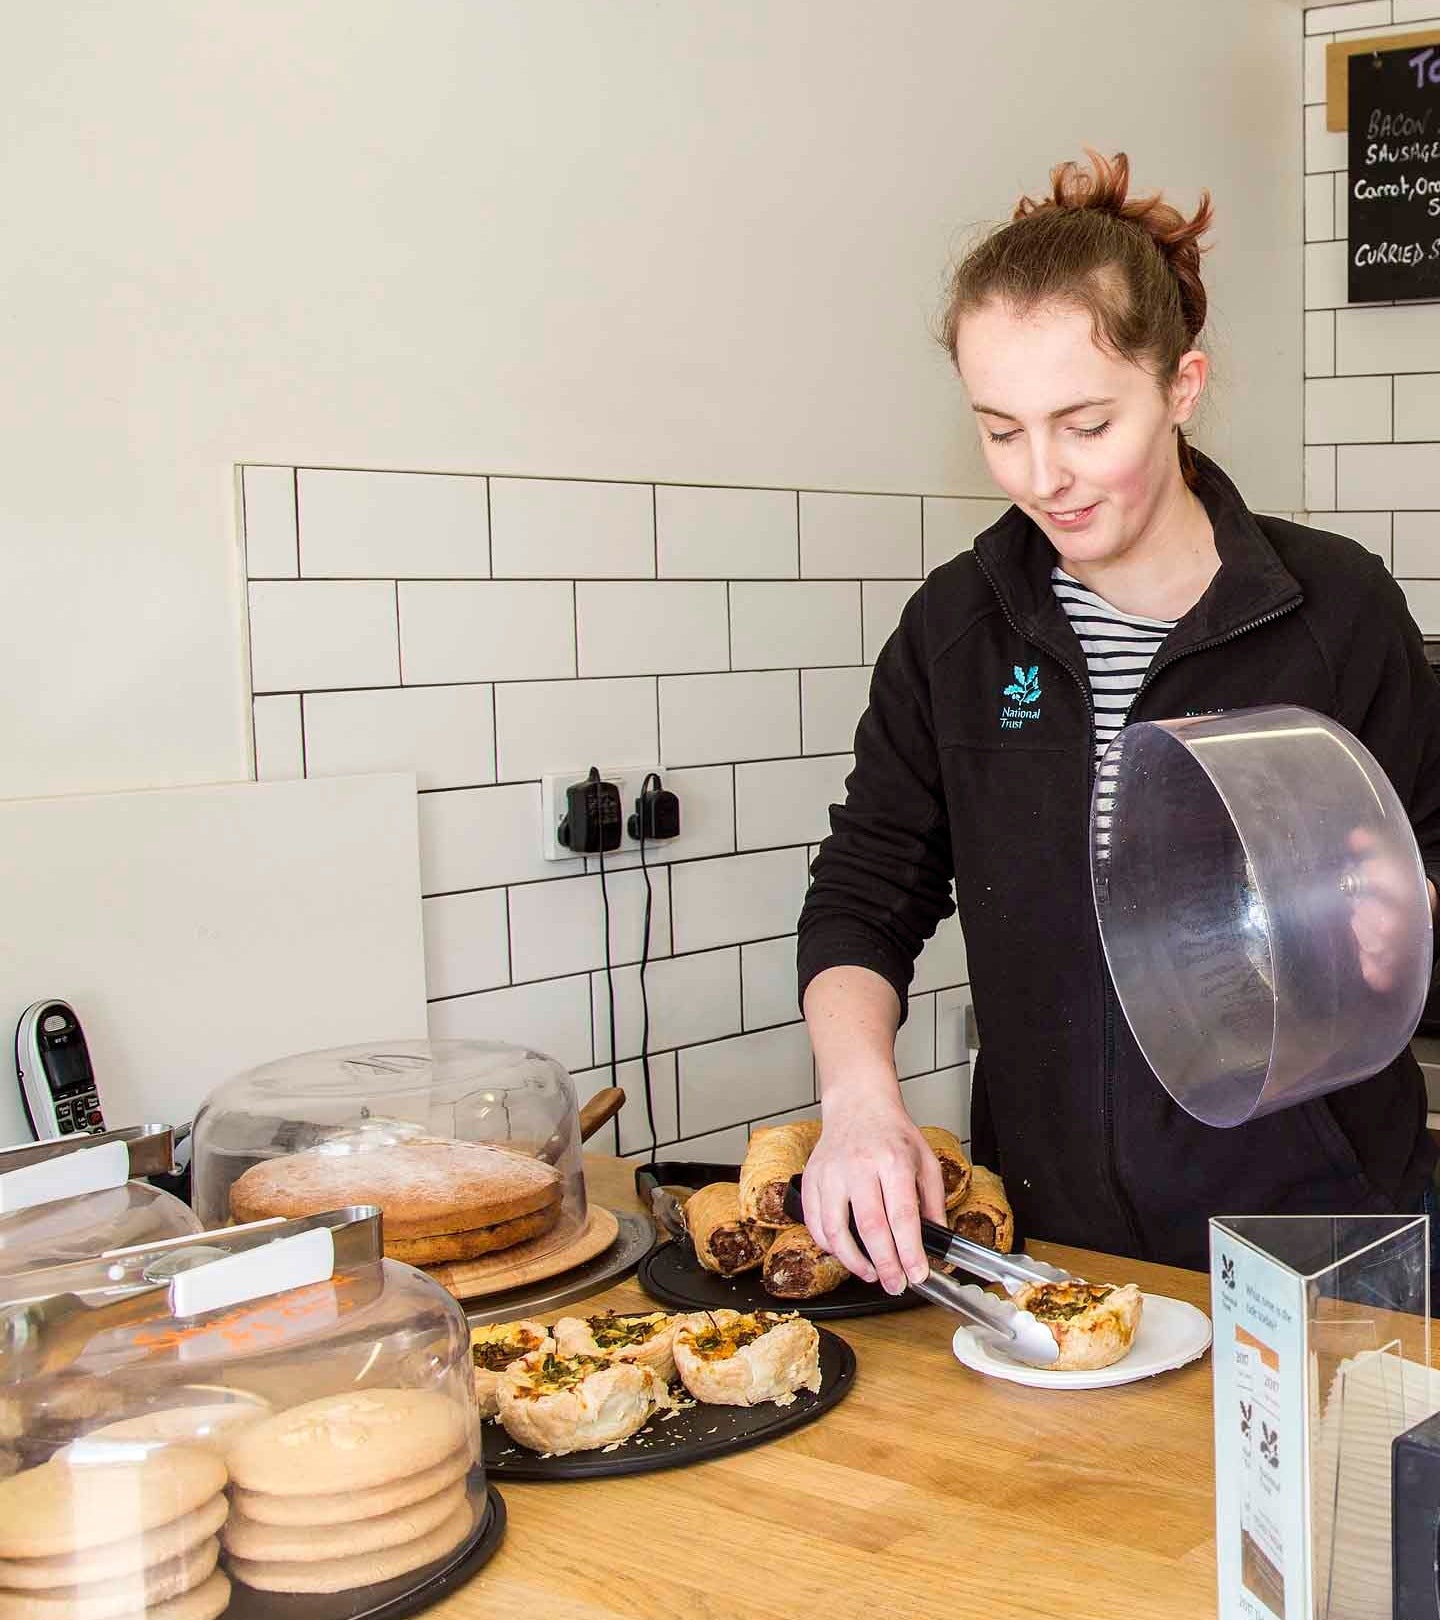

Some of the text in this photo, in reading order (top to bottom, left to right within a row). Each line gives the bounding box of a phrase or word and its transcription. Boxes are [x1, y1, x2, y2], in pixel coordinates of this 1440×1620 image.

[1365, 141, 1440, 165] SAUSAGE
[1355, 243, 1422, 267] CURRIED
[1002, 707, 1040, 720] National
[1000, 719, 1022, 729] Trust
